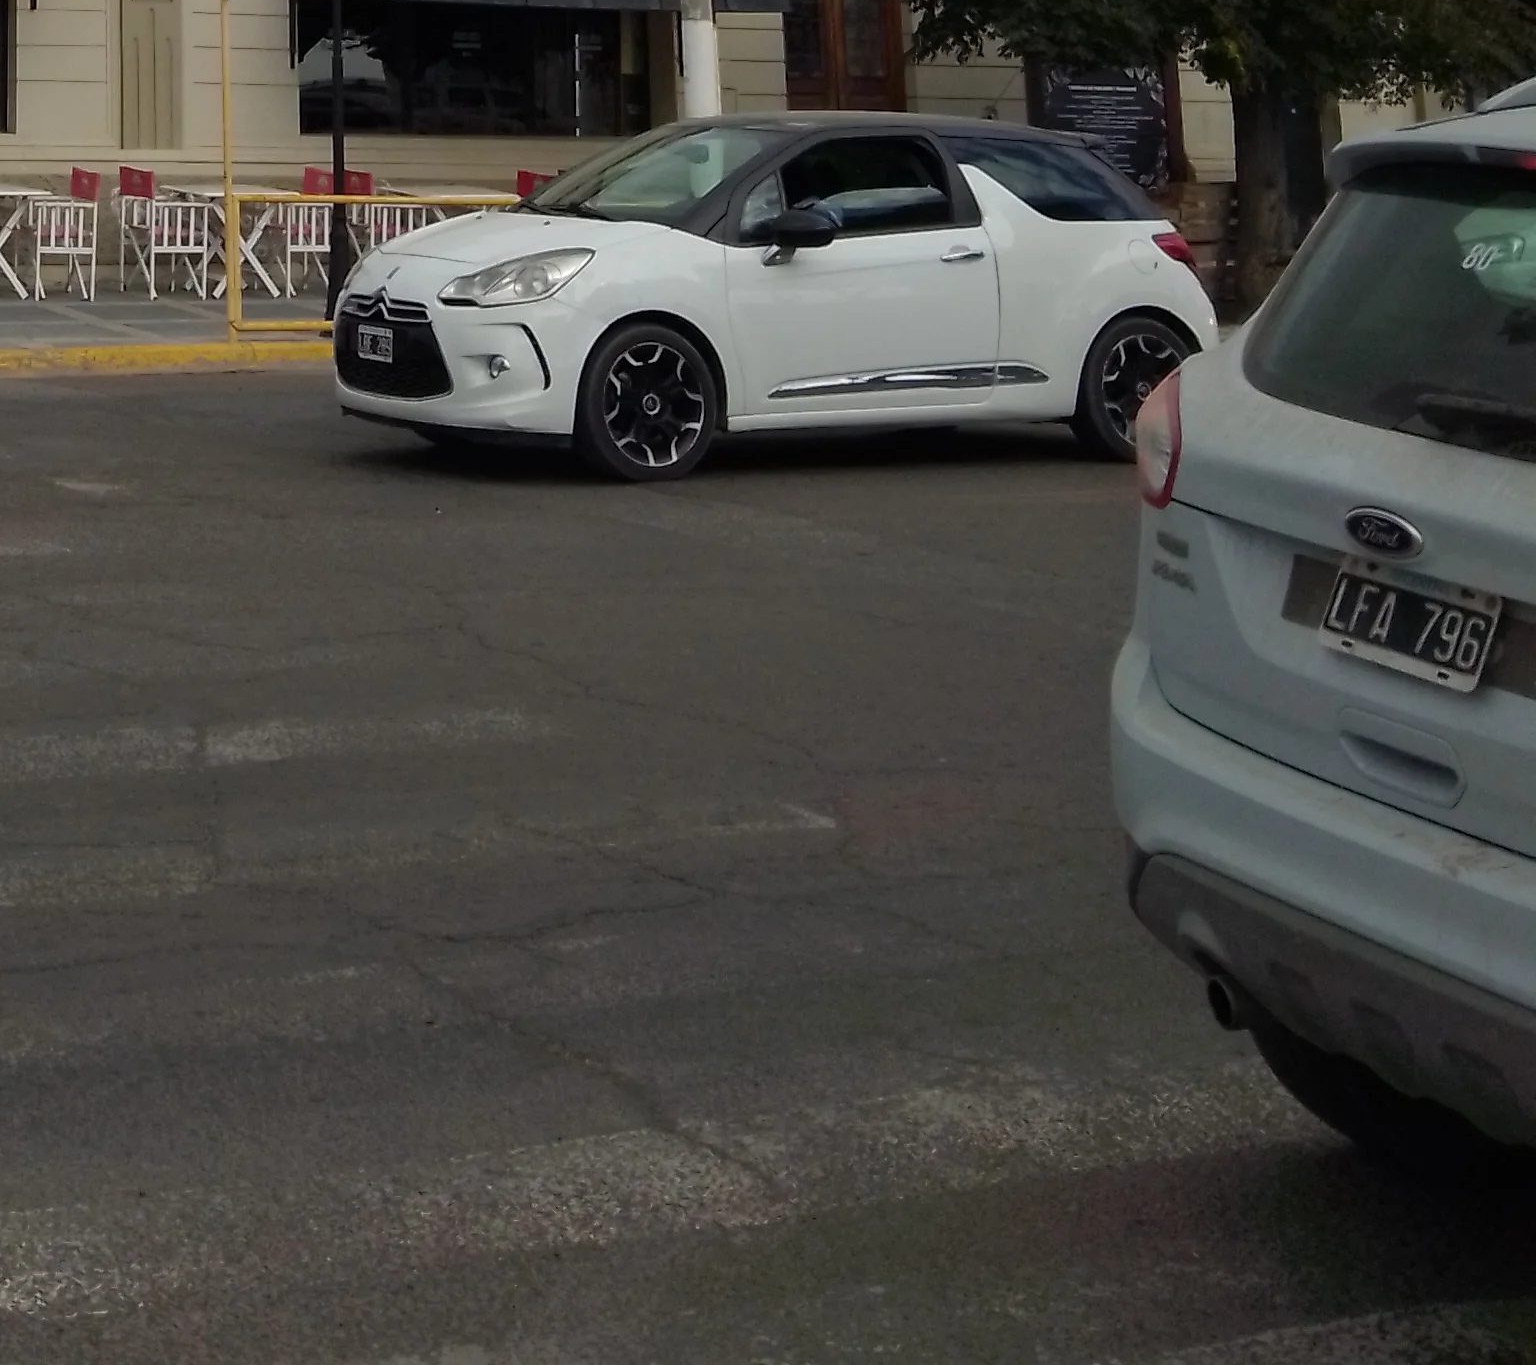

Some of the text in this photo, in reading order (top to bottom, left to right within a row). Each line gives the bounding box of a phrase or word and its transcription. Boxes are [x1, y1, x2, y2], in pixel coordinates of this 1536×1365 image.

[1358, 517, 1401, 549] Ford
[1326, 577, 1486, 670] LFA 796
